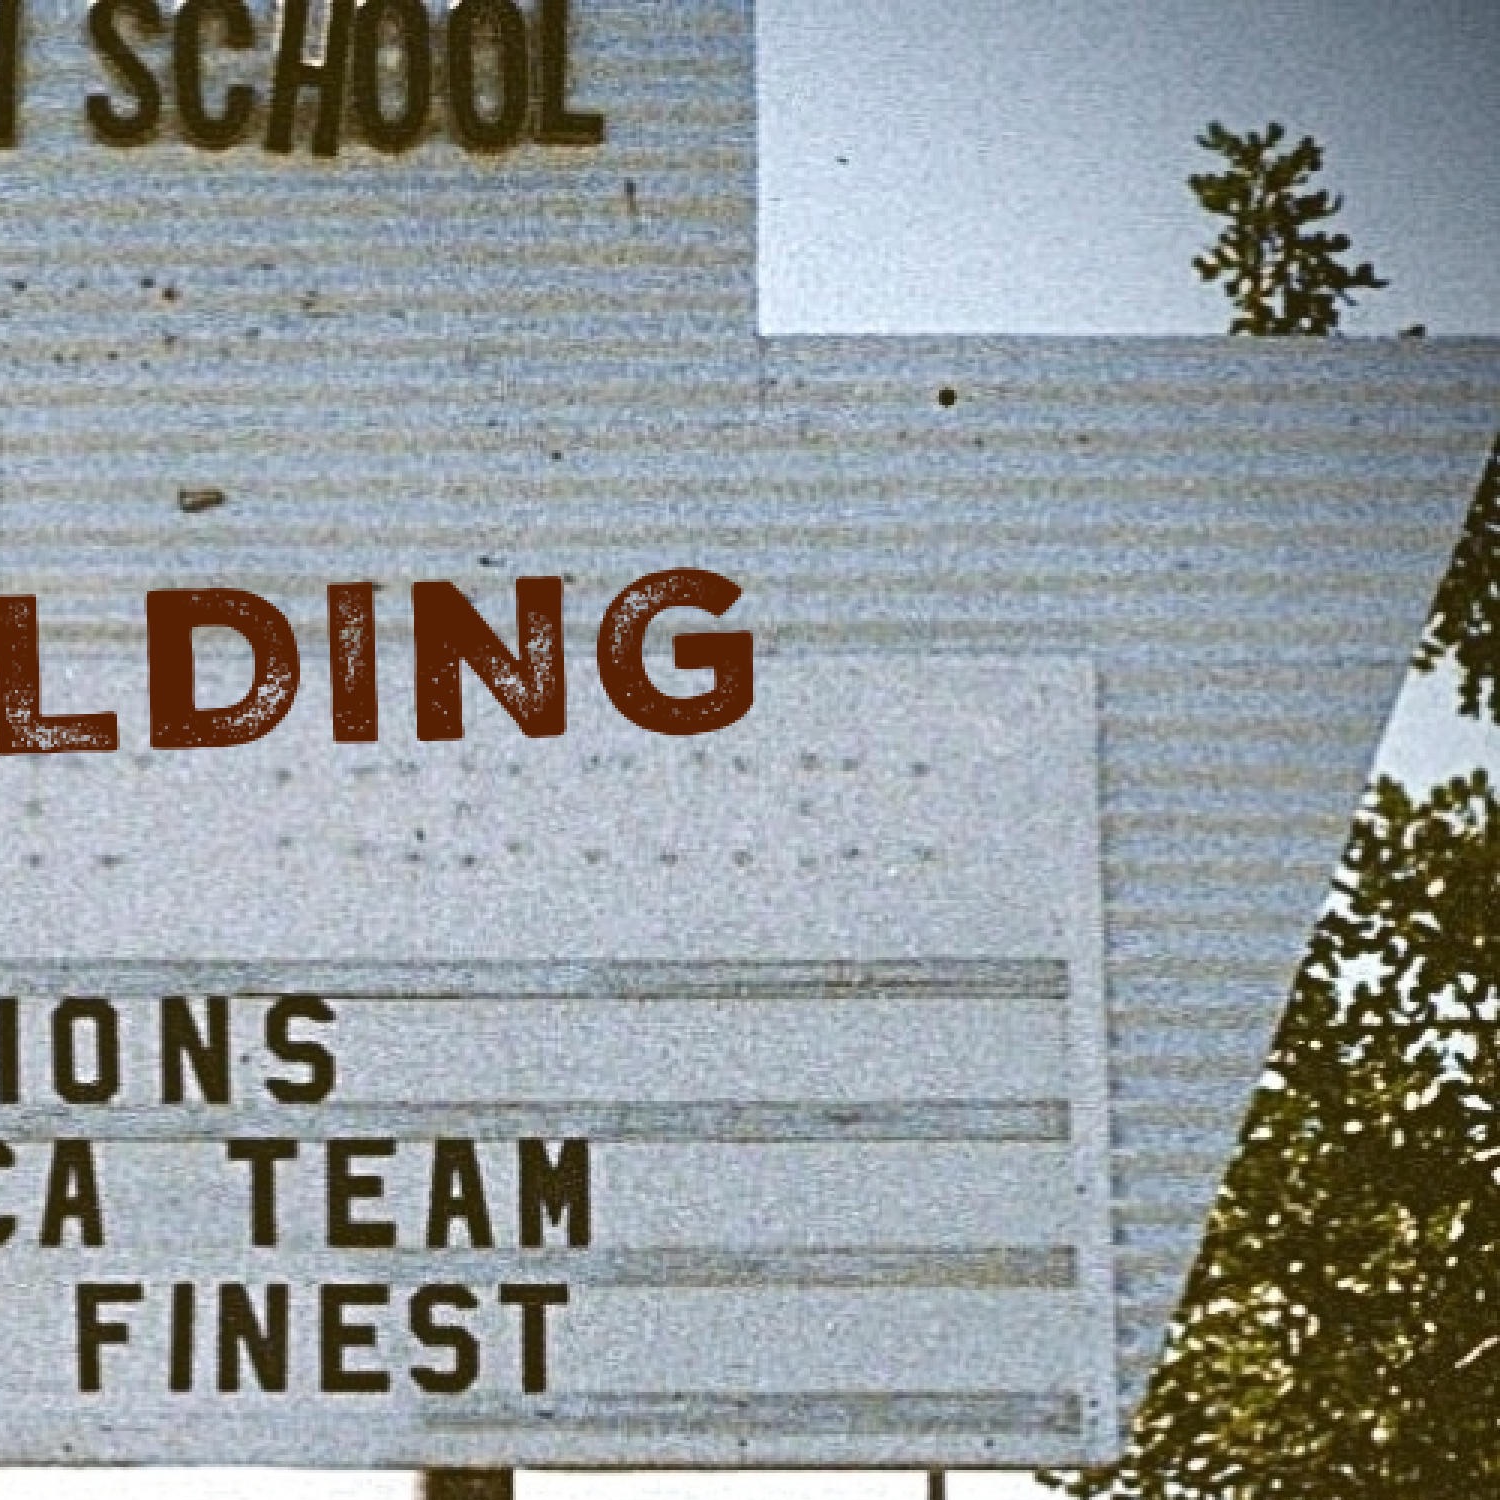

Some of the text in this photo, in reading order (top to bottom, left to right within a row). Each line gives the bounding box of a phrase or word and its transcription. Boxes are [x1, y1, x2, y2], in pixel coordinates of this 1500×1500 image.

[81, 0, 608, 158] SCHOOL
[225, 1136, 592, 1249] TEAM
[77, 1282, 570, 1395] FINEST
